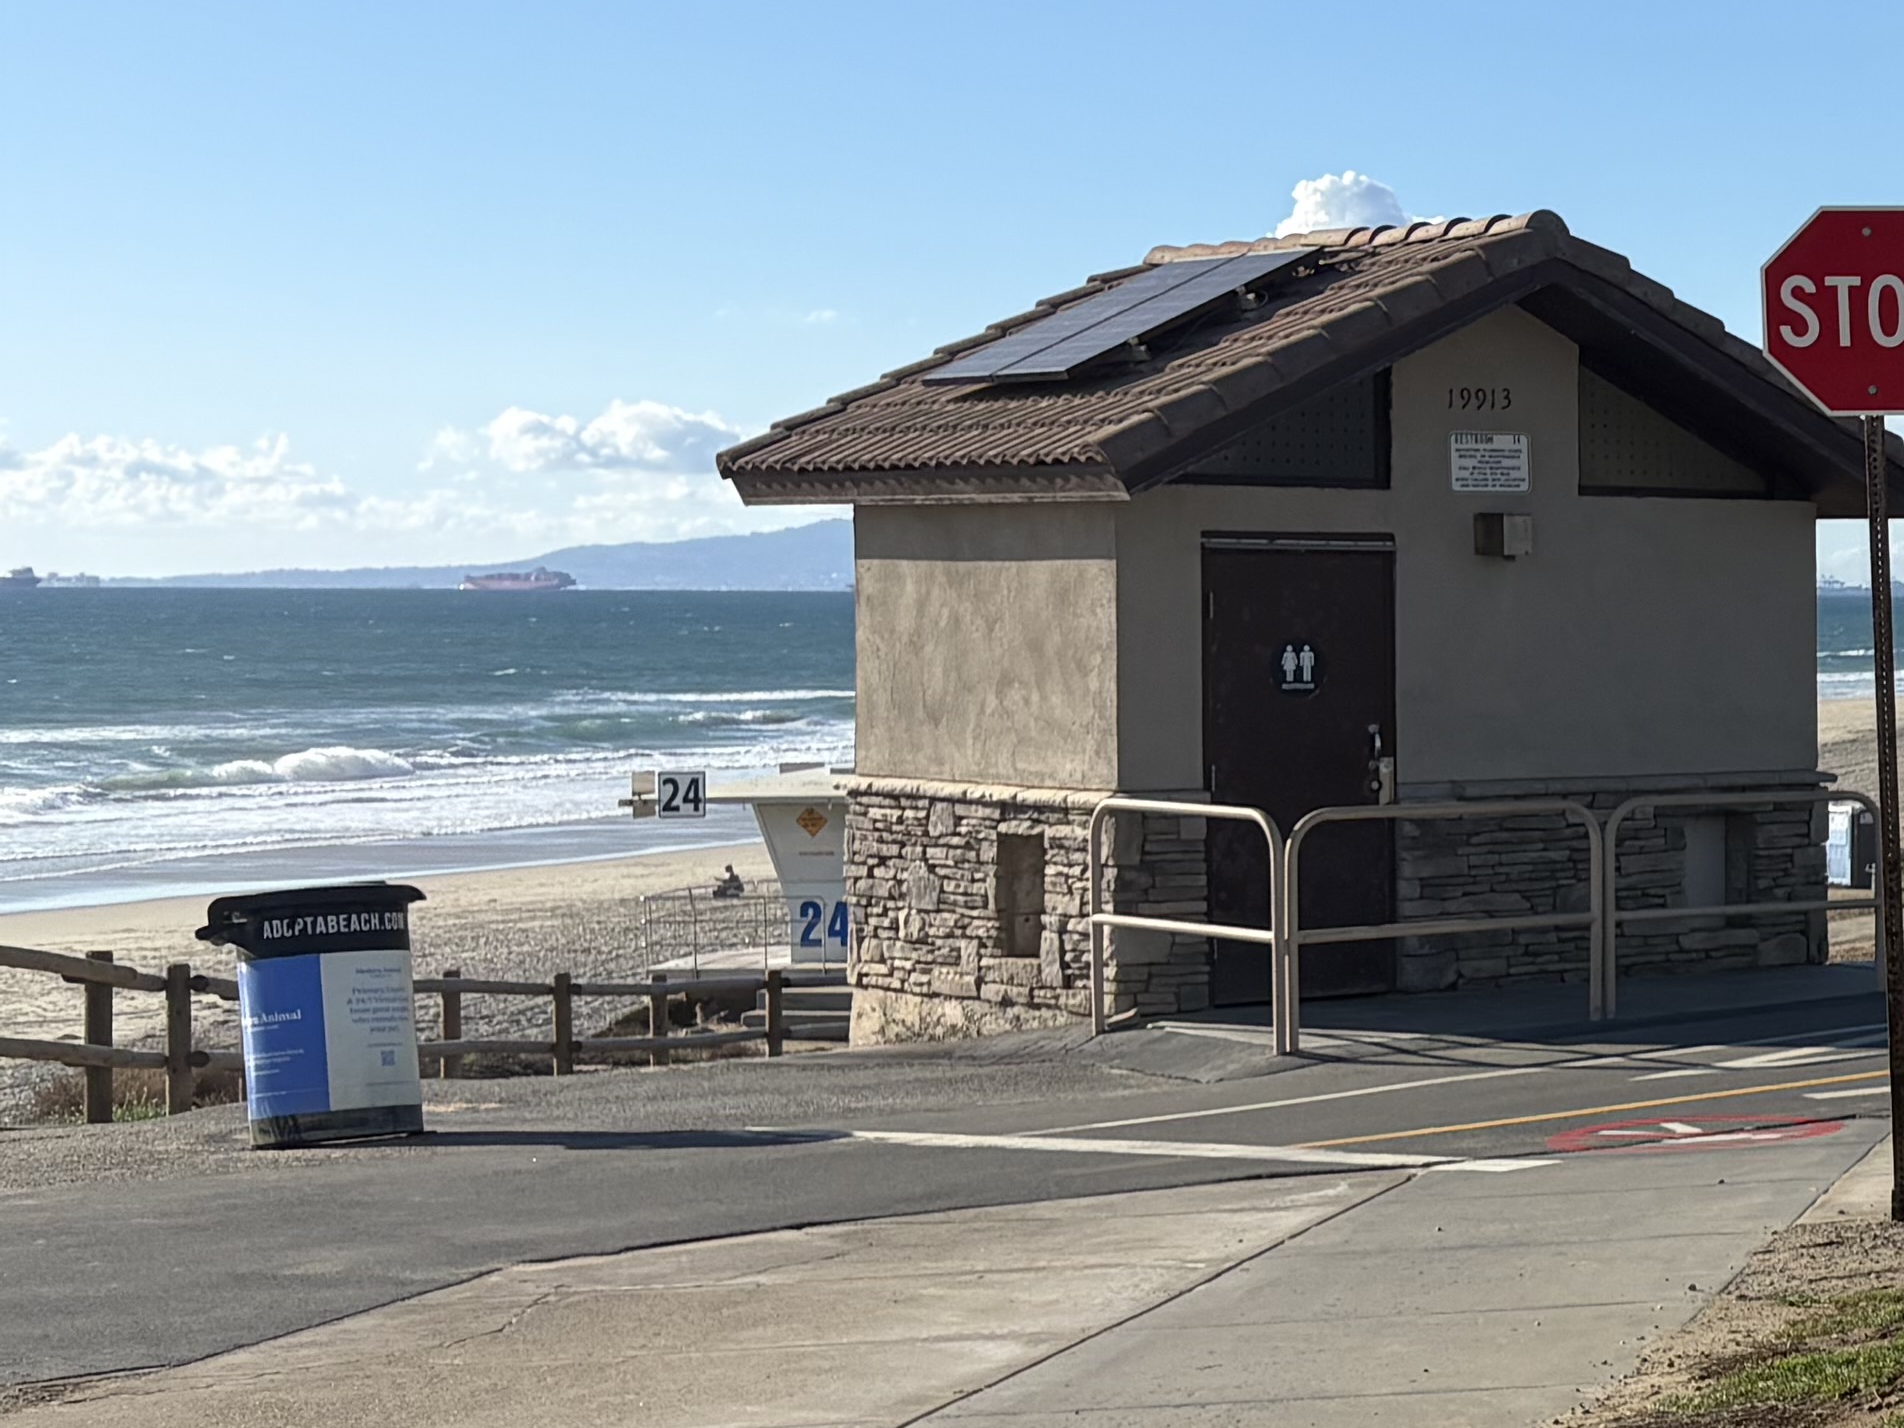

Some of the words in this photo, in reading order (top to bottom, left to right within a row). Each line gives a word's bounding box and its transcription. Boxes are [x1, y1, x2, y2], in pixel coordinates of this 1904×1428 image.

[1448, 387, 1512, 411] 19913
[662, 777, 702, 813] 24
[263, 911, 405, 940] ADOPTABEACH.COM
[800, 900, 849, 948] 24
